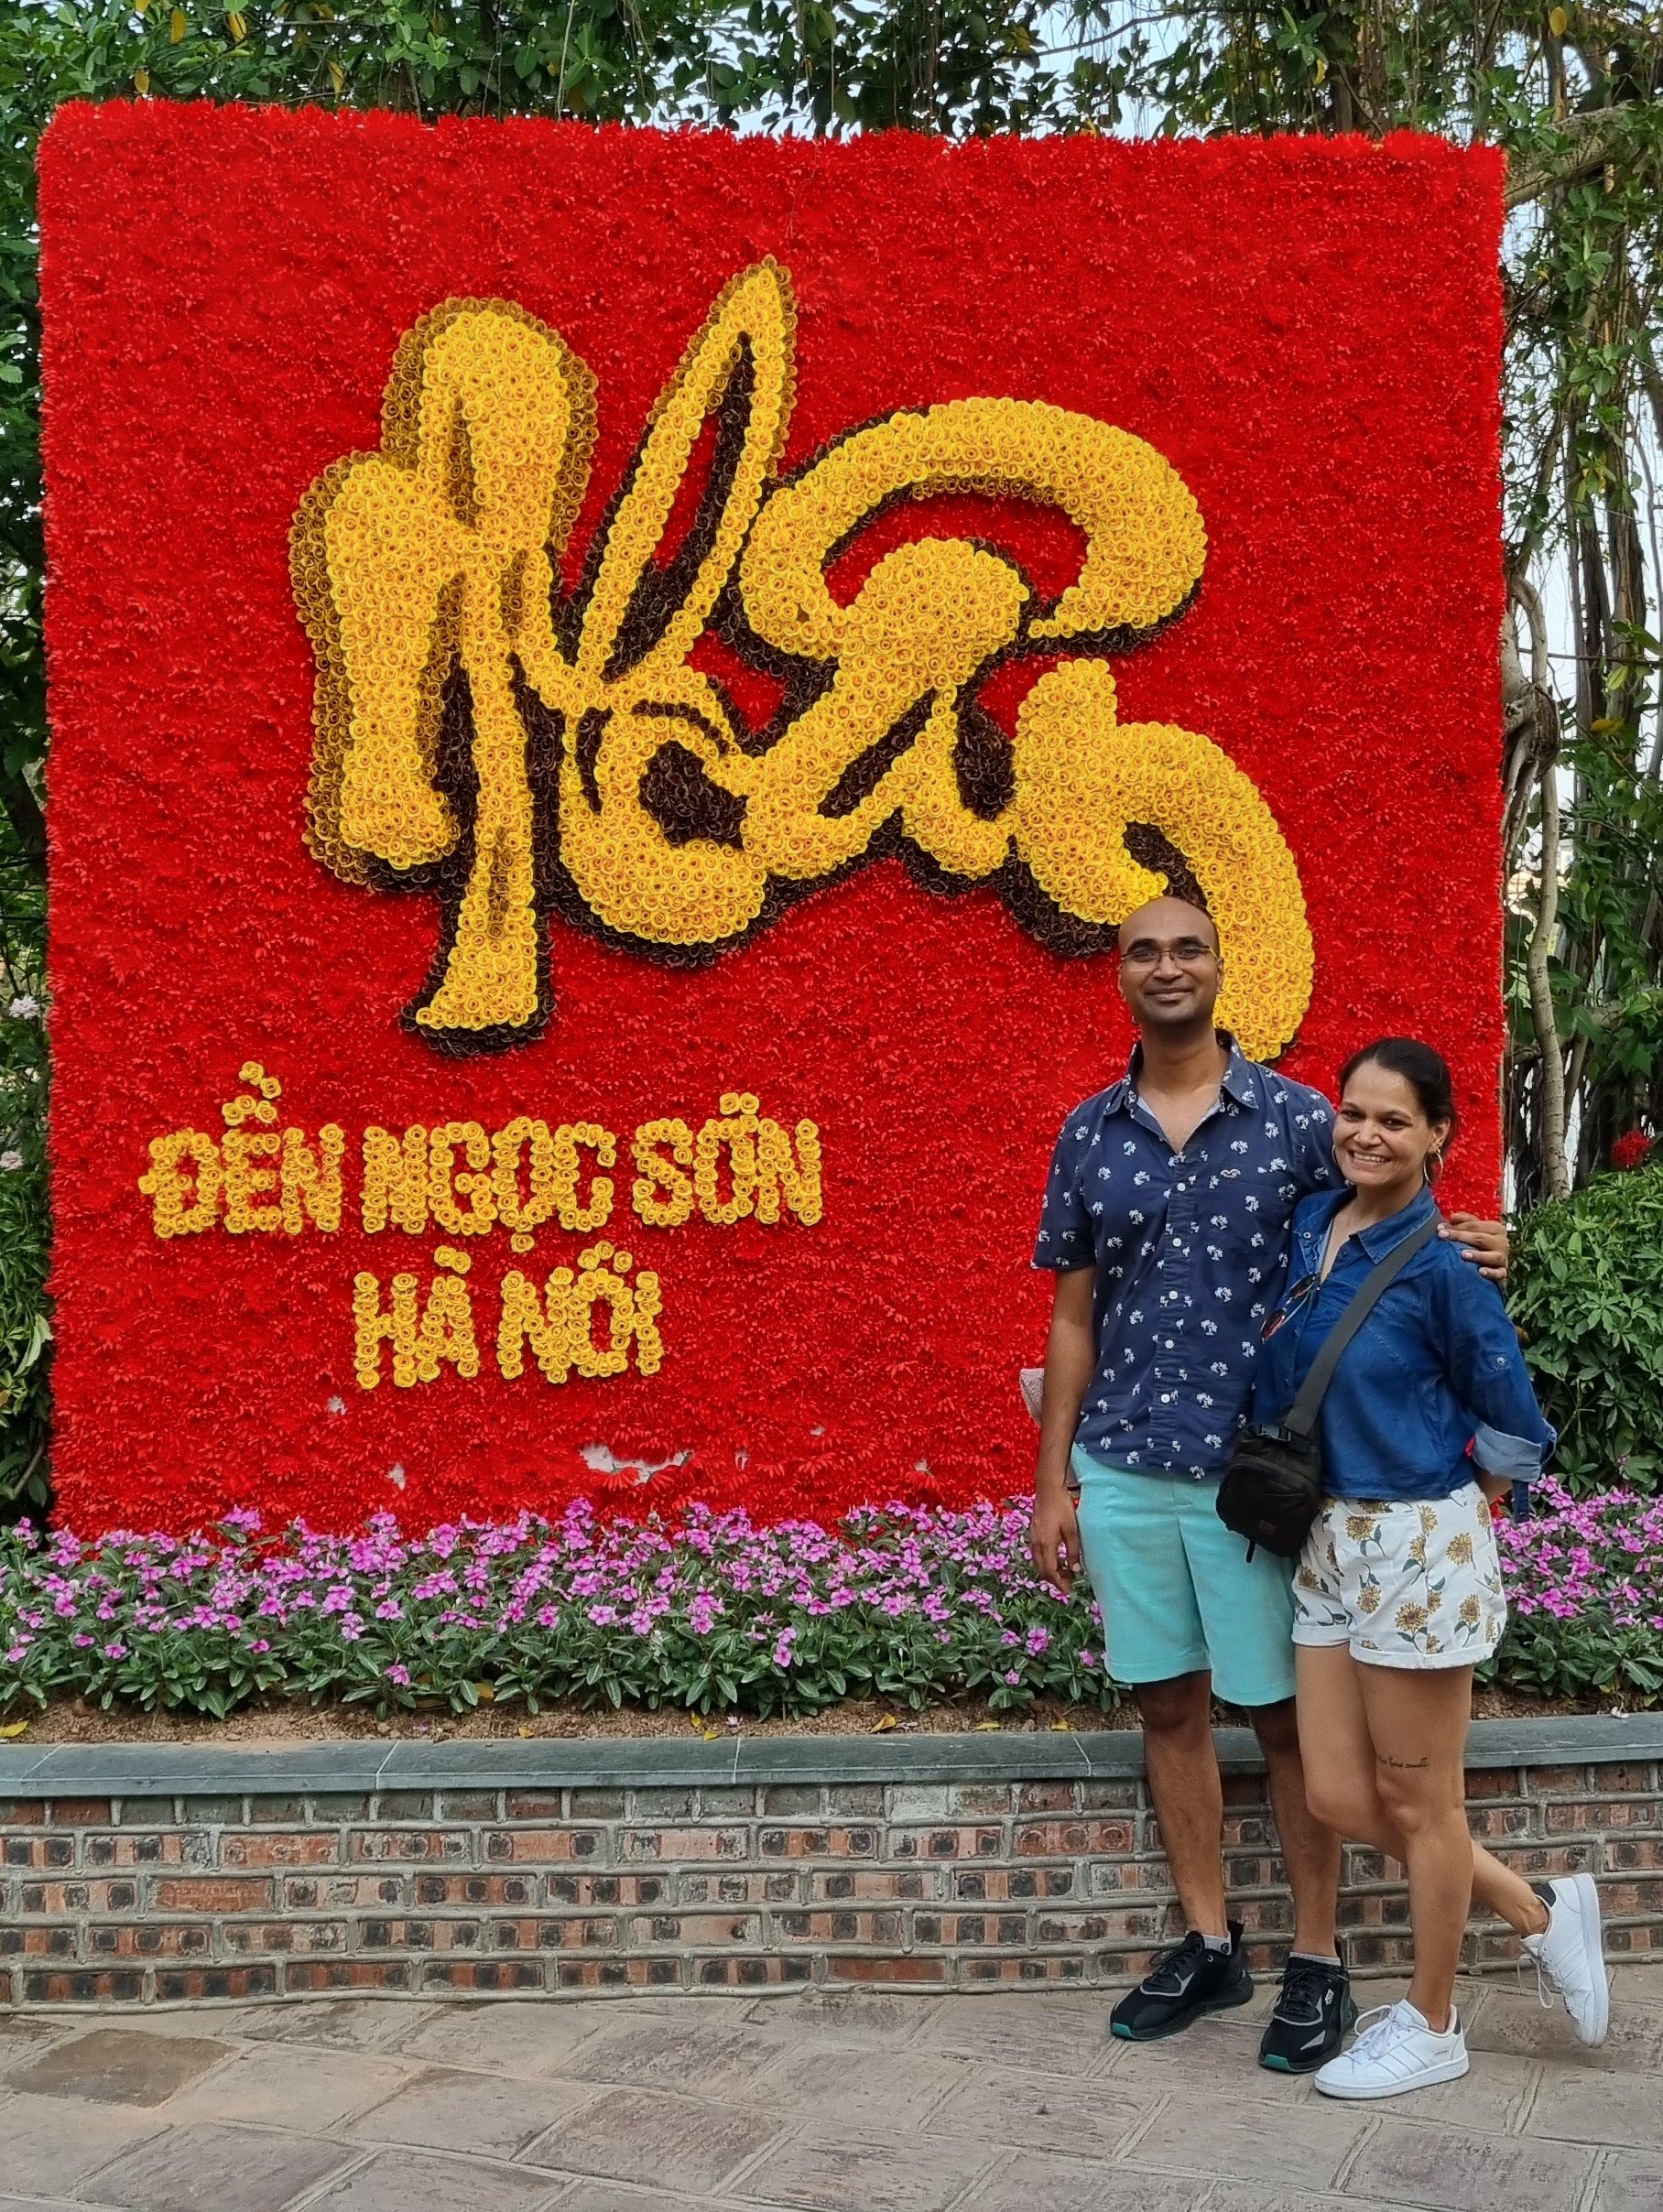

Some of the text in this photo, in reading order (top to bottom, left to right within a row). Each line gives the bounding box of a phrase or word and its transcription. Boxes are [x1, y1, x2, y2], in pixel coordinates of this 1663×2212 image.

[138, 1061, 345, 1239] ĐỀN
[361, 1116, 616, 1252] NGỌC
[353, 1245, 480, 1390] HÀ
